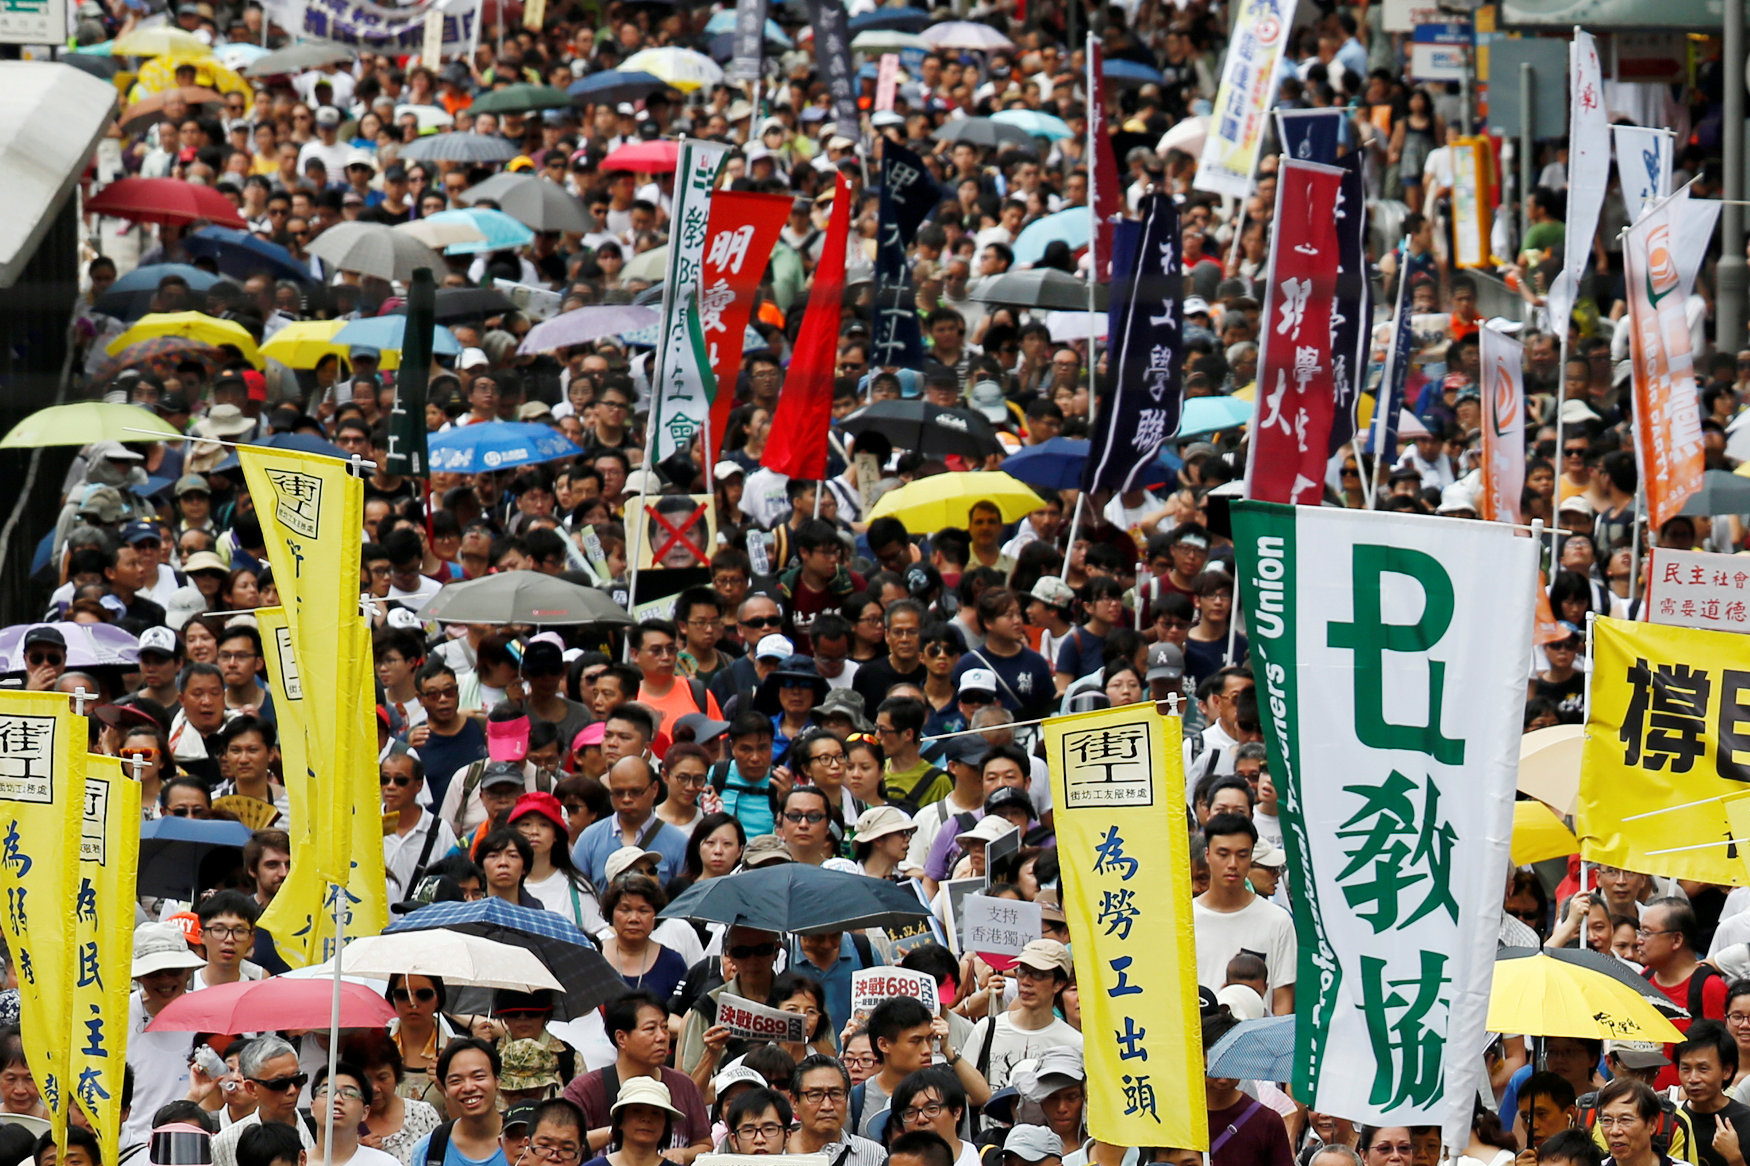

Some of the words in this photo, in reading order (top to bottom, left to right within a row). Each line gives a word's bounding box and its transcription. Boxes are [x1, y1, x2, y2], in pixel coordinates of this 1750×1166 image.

[1252, 535, 1285, 639] Union
[1663, 562, 1749, 590] 民主社會
[1660, 598, 1748, 623] 需要道德
[1069, 730, 1146, 786] 街工
[1069, 788, 1148, 801] 街坊工友服務處
[987, 905, 1019, 925] 支持
[969, 924, 1034, 947] 香港獨立
[855, 976, 921, 999] 決戰689
[1092, 825, 1161, 1126] 為勞工出頭
[720, 1003, 788, 1035] 決戰689
